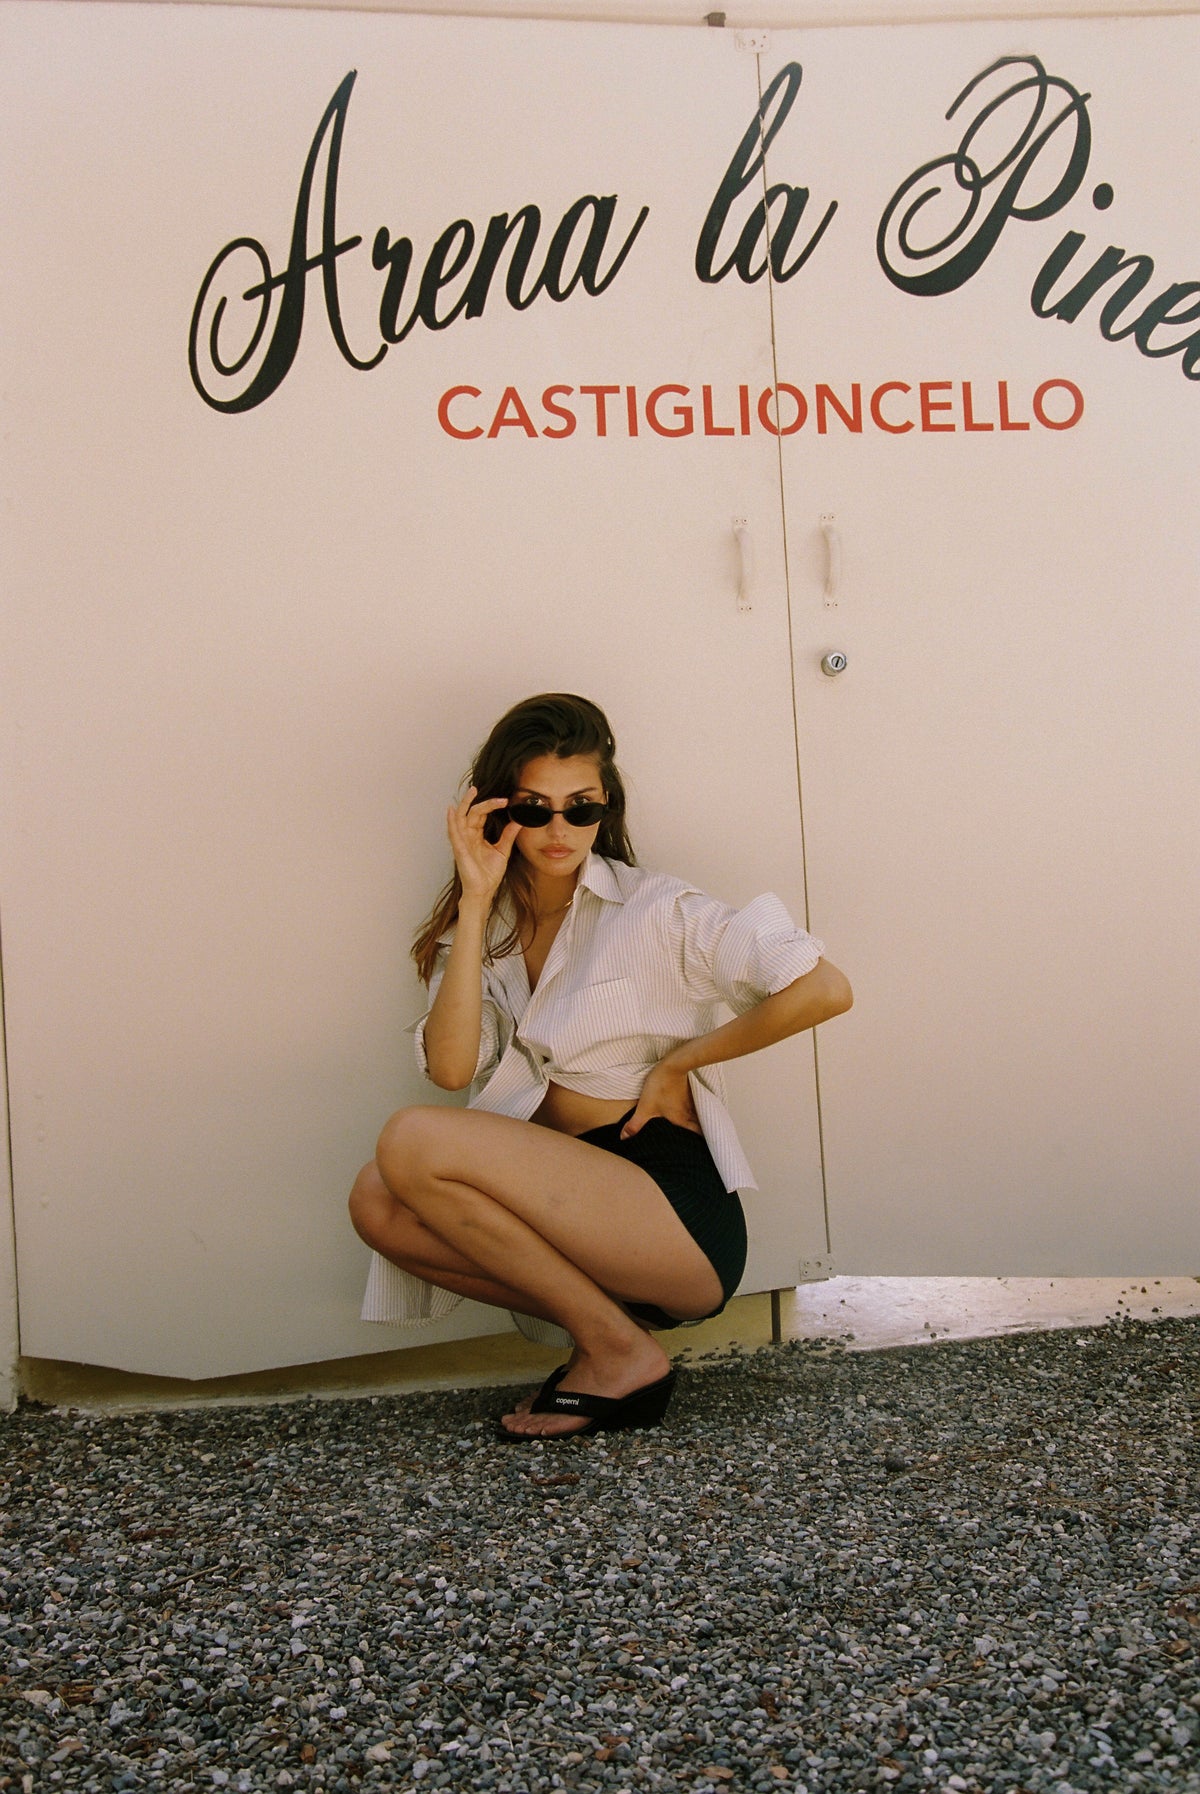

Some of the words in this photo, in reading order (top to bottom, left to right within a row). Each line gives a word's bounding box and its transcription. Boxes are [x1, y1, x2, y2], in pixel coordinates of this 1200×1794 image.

[188, 69, 649, 415] Arena
[695, 62, 839, 285] la
[437, 380, 1084, 440] CASTIGLIONCELLO
